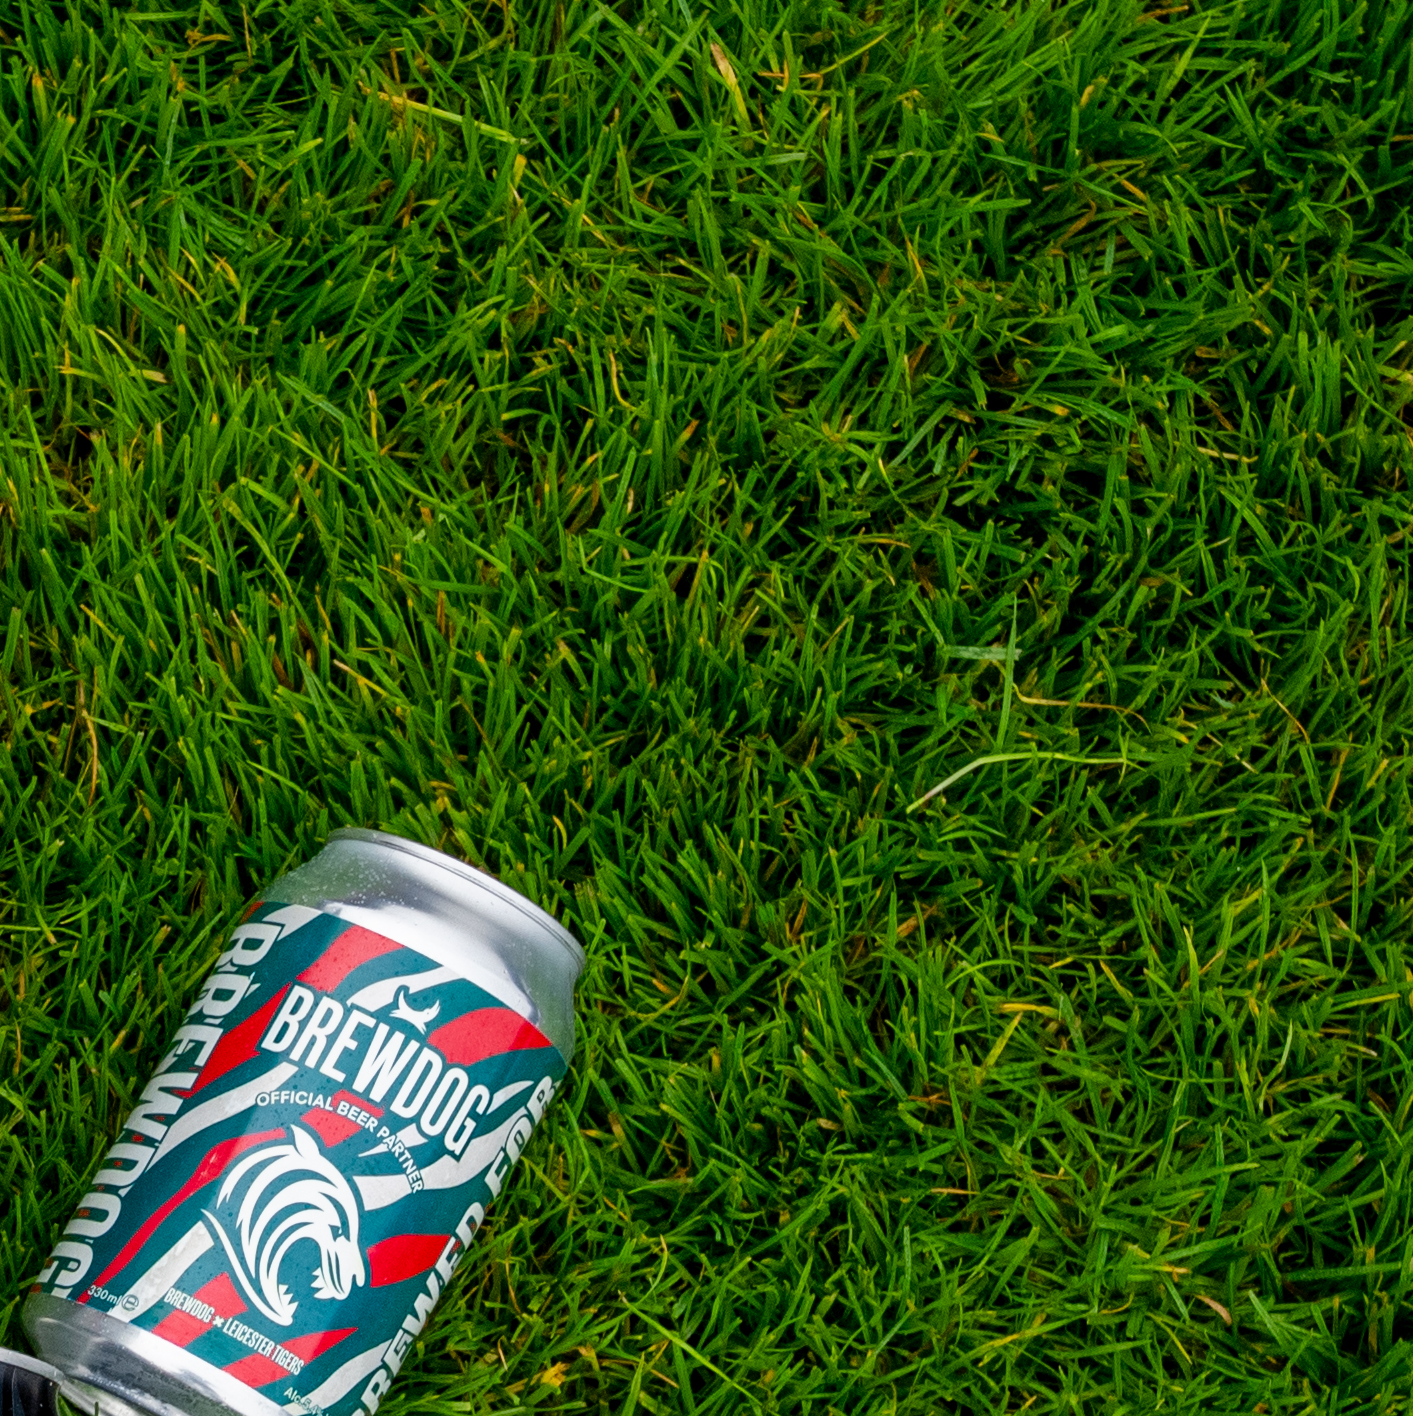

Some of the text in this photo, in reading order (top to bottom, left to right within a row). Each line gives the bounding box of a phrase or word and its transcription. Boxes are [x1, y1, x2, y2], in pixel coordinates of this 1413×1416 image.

[260, 984, 490, 1156] BREWDOG
[256, 1091, 423, 1194] OFFICIAL BEER PARTNER
[87, 1285, 122, 1306] 330ml
[164, 1288, 215, 1324] BREWDOG
[223, 1318, 275, 1358] LEICESTER
[272, 1343, 305, 1376] TIGERS
